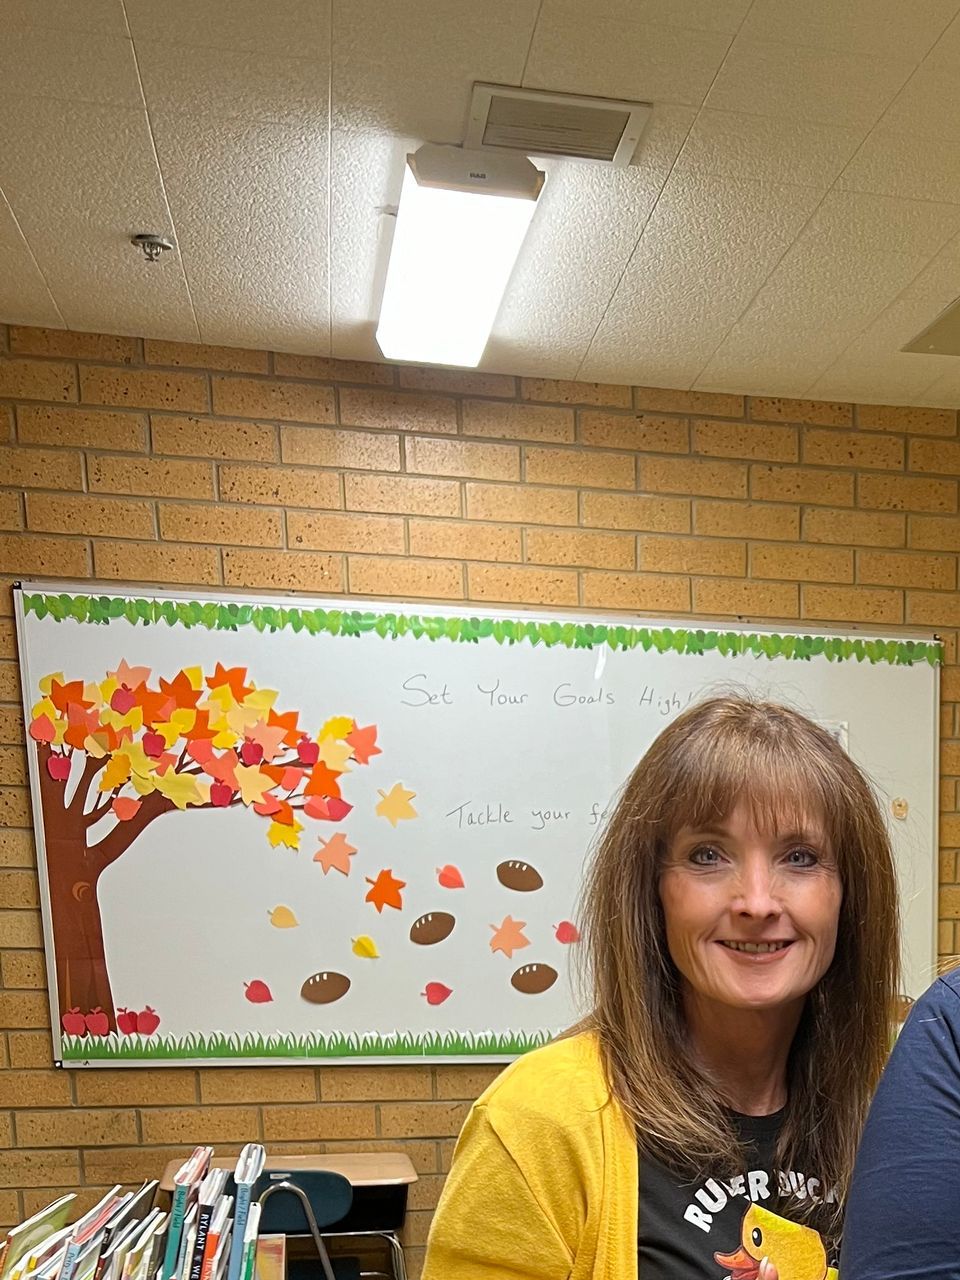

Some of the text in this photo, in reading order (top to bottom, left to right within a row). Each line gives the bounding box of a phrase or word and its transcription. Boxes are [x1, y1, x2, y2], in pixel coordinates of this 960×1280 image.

[401, 673, 453, 707] Set
[477, 678, 529, 706] Your
[553, 682, 616, 707] Goals
[446, 800, 514, 828] Tackle
[531, 808, 571, 830] your
[195, 1213, 209, 1249] RYLANT
